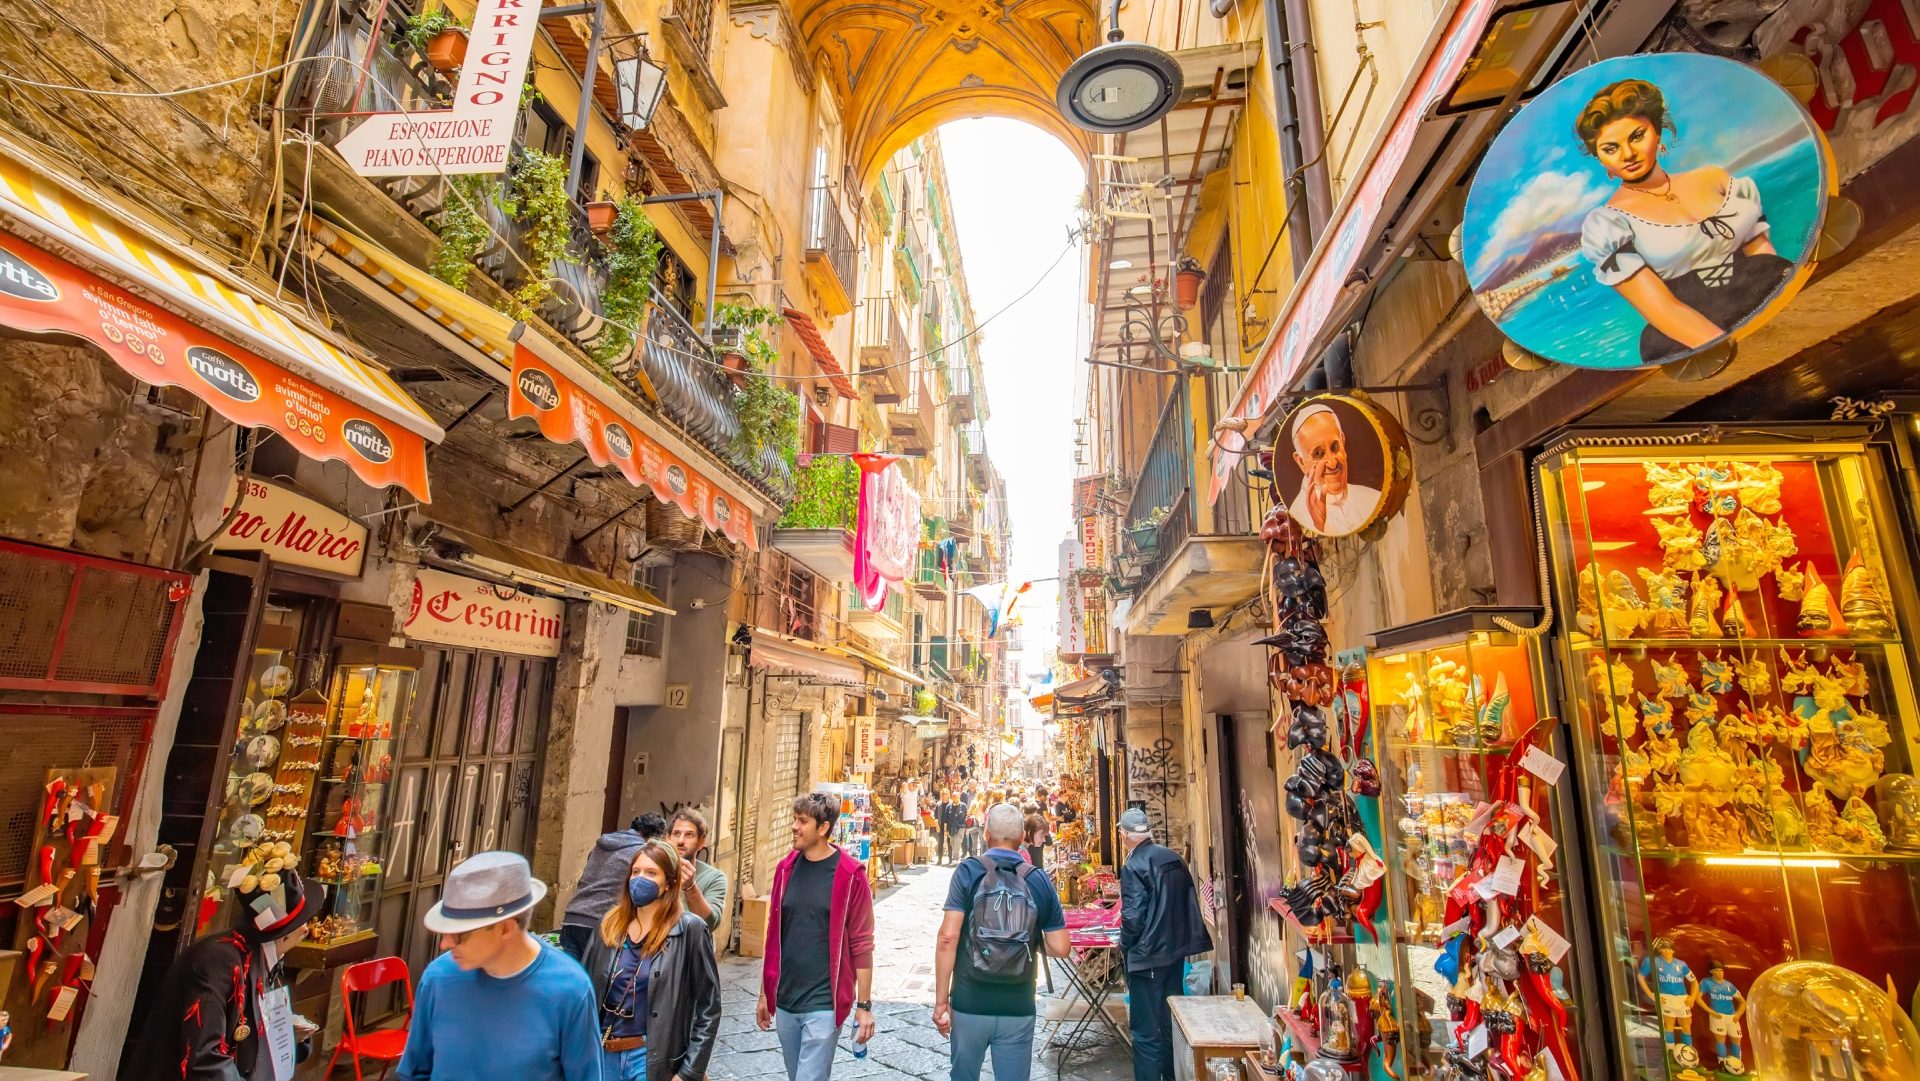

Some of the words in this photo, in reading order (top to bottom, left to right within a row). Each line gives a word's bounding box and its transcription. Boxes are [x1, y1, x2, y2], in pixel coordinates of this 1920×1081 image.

[388, 118, 493, 140] ESPOSIZIONE
[364, 148, 414, 168] PIANO
[416, 144, 506, 166] SUPERIORE
[0, 260, 57, 298] tta
[82, 289, 130, 320] avimm
[133, 313, 167, 336] fatto
[98, 286, 114, 300] San
[116, 296, 153, 319] Gregorio
[202, 352, 225, 367] caffè
[191, 356, 258, 398] motta
[520, 377, 558, 407] motta
[275, 384, 308, 405] avimm
[309, 398, 330, 415] fatto
[346, 429, 391, 458] motta
[606, 430, 631, 454] motta
[261, 511, 360, 561] Marco
[426, 590, 560, 639] Cesarini
[670, 689, 685, 706] 12
